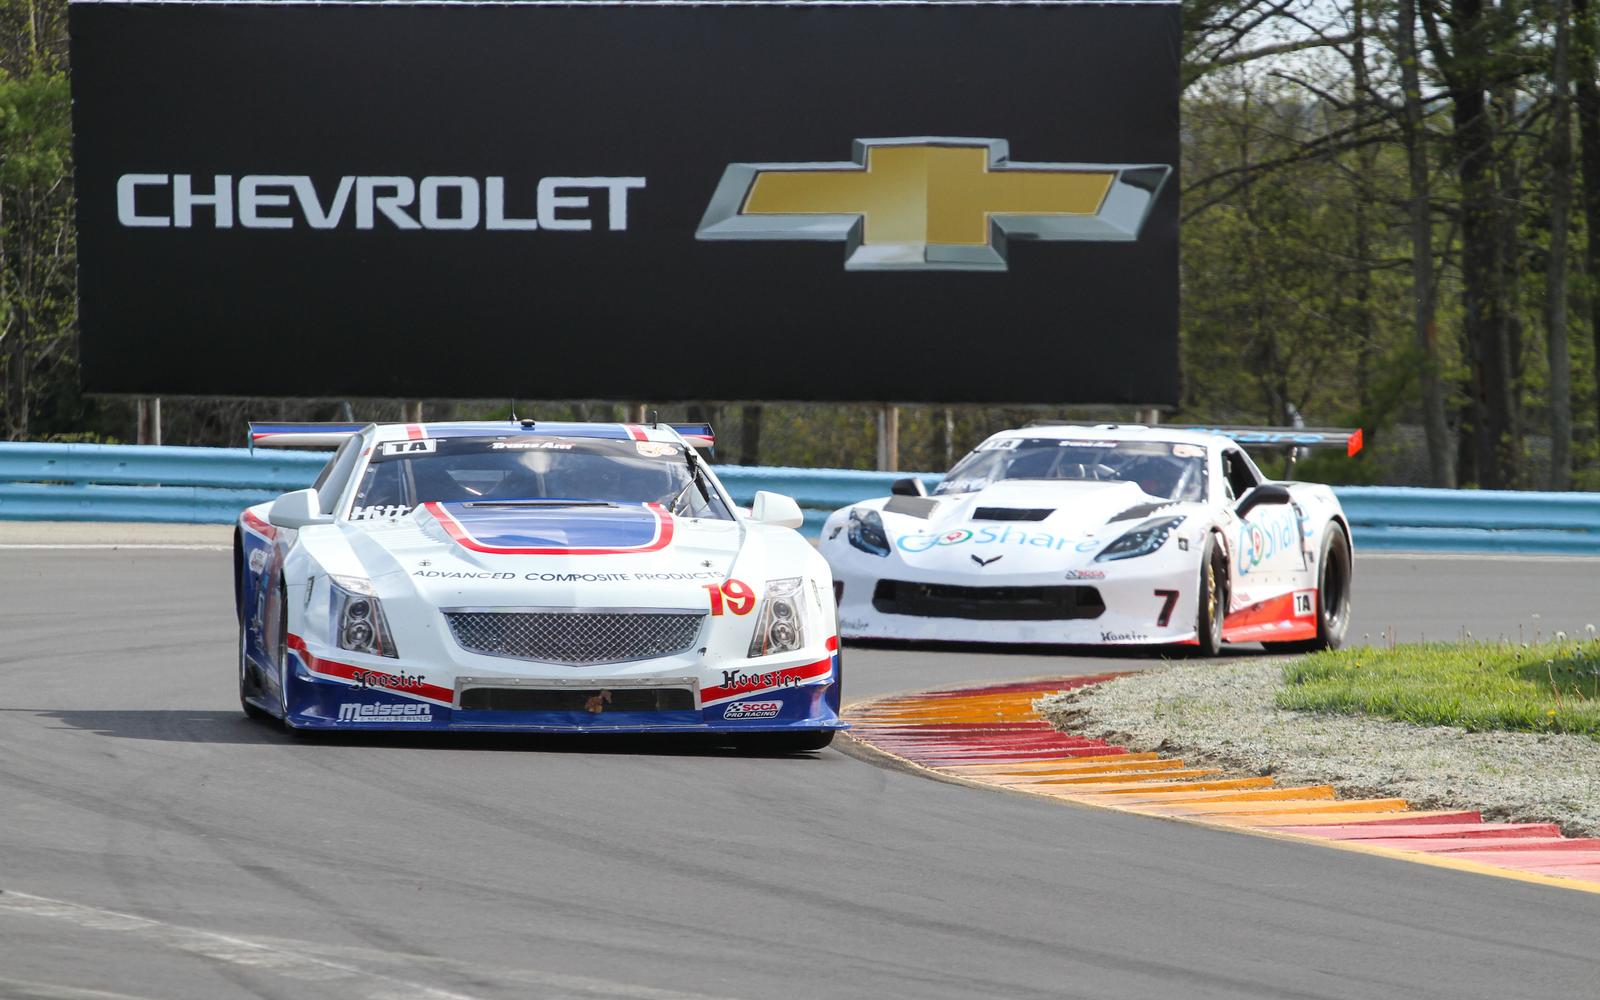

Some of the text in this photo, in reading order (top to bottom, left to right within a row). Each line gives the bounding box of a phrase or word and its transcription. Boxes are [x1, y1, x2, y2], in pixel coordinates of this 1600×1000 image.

[117, 174, 646, 231] CHEVROLET
[392, 442, 427, 453] TA
[351, 504, 413, 520] Hitt
[412, 569, 726, 582] ADVANCED COMPOSITE PRODUCTS
[702, 578, 756, 617] 19
[1296, 594, 1311, 612] TA
[1153, 589, 1181, 628] 7
[348, 669, 426, 692] Hoosier
[719, 669, 803, 690] Hoosier
[337, 701, 431, 723] Meissen
[726, 710, 777, 719] PRO RACING
[742, 703, 778, 712] SCCA
